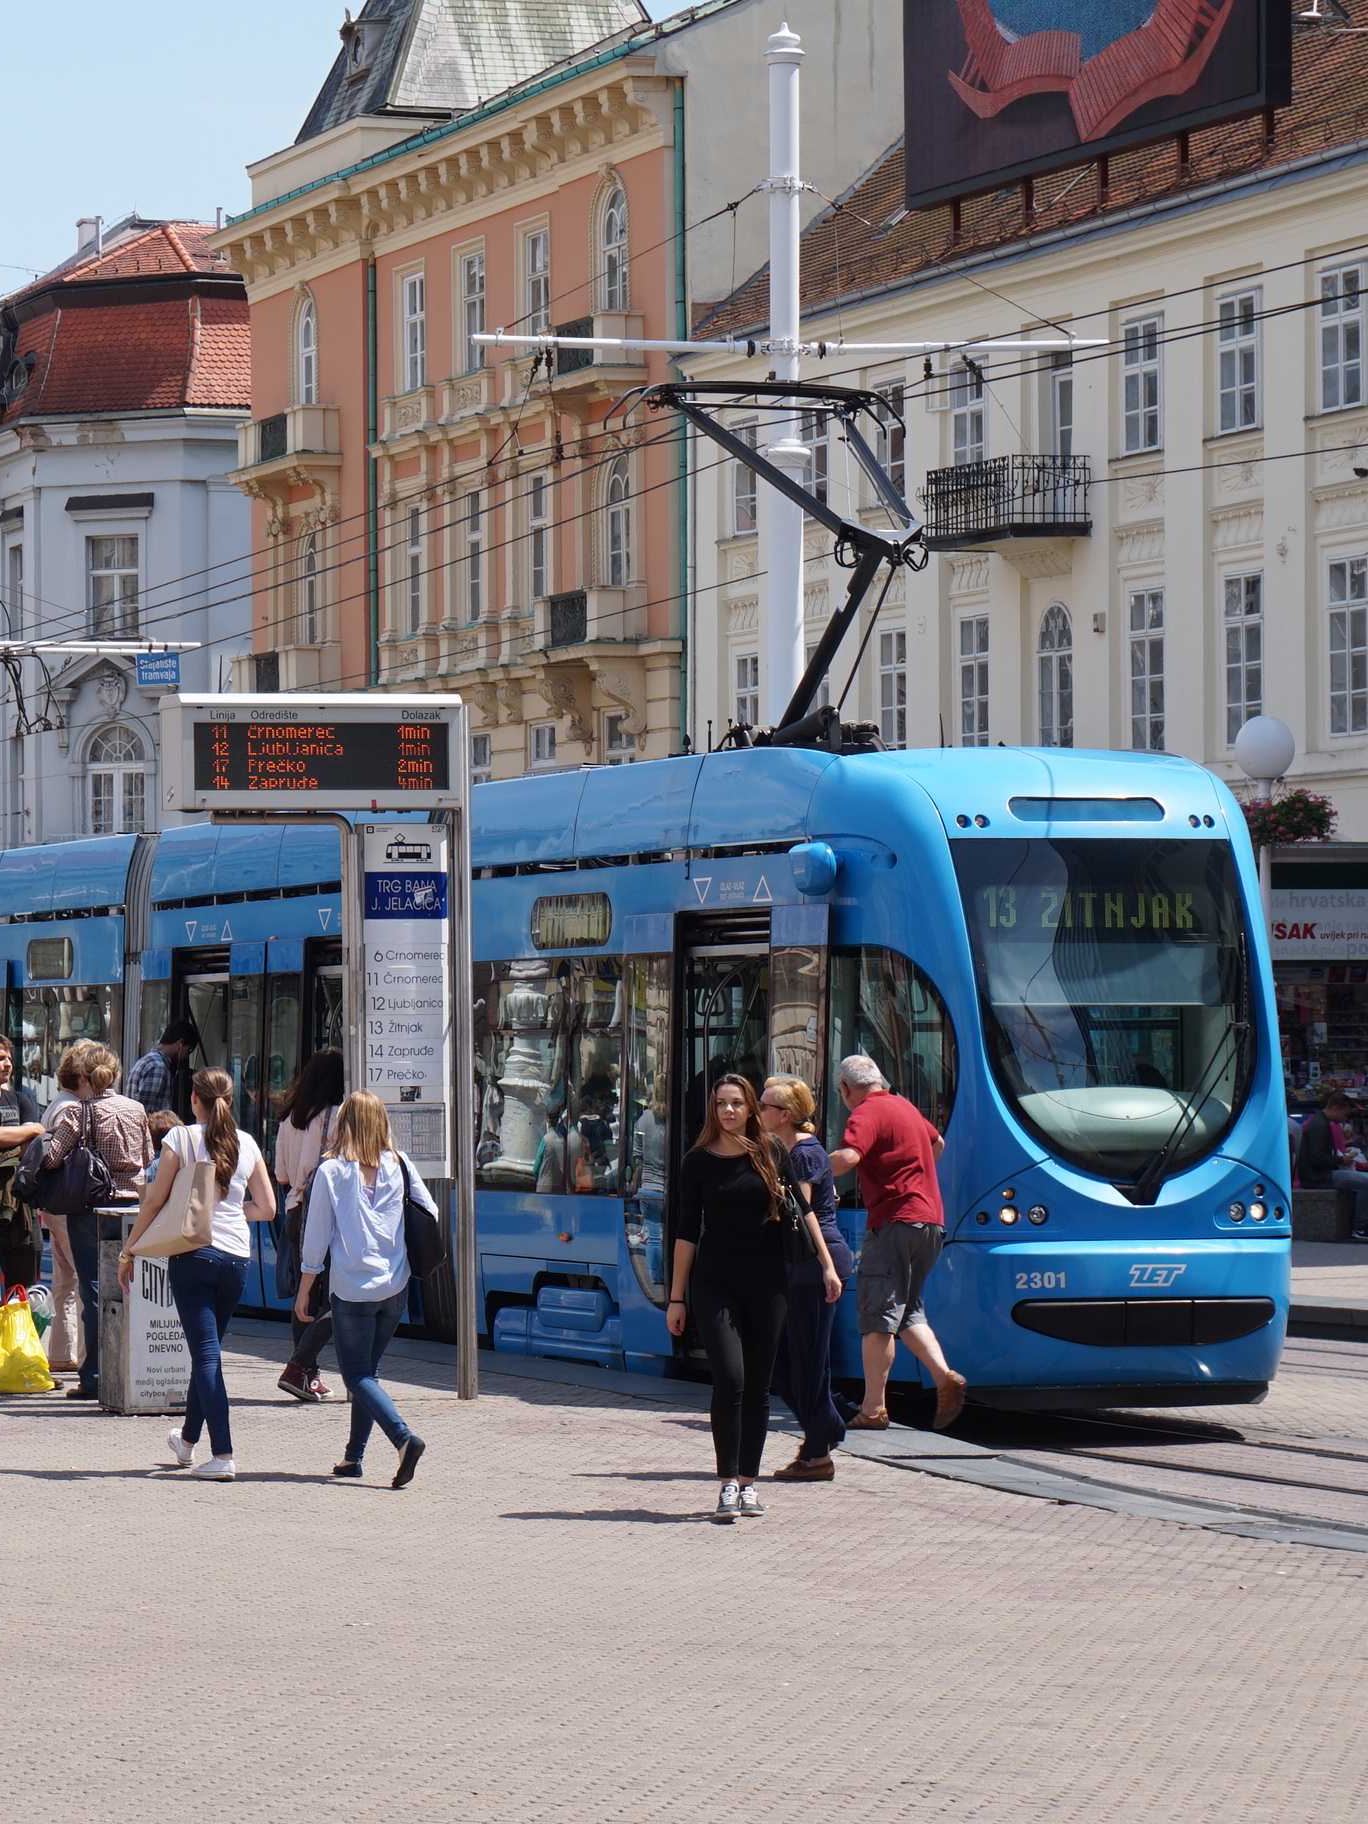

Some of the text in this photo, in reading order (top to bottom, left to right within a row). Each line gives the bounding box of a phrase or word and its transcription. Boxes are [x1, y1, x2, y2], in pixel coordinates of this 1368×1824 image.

[142, 670, 177, 681] tramvaja
[210, 710, 441, 721] Linija Odredište Dolazak
[211, 725, 229, 739] 11
[397, 725, 431, 739] 1min
[211, 742, 431, 756] 12 Ljubljanica 1min
[211, 759, 230, 773] 17
[398, 759, 433, 773] 2min
[211, 775, 231, 790] 14
[398, 775, 433, 790] 4min
[376, 879, 438, 894] TRG BANA
[371, 897, 381, 911] J.
[984, 885, 1017, 928] 13
[1272, 922, 1318, 940] SAK
[374, 950, 384, 963] 6
[367, 971, 379, 986] 11
[371, 996, 385, 1011] 12
[369, 1018, 423, 1035] 13 Žitnjak
[369, 1043, 384, 1058] 14
[369, 1067, 425, 1082] 17 Prečko
[1015, 1263, 1188, 1289] 2301 ZET
[146, 1331, 185, 1341] POGLEDA
[148, 1343, 183, 1353] DNEVNO
[146, 1366, 162, 1374] Novi
